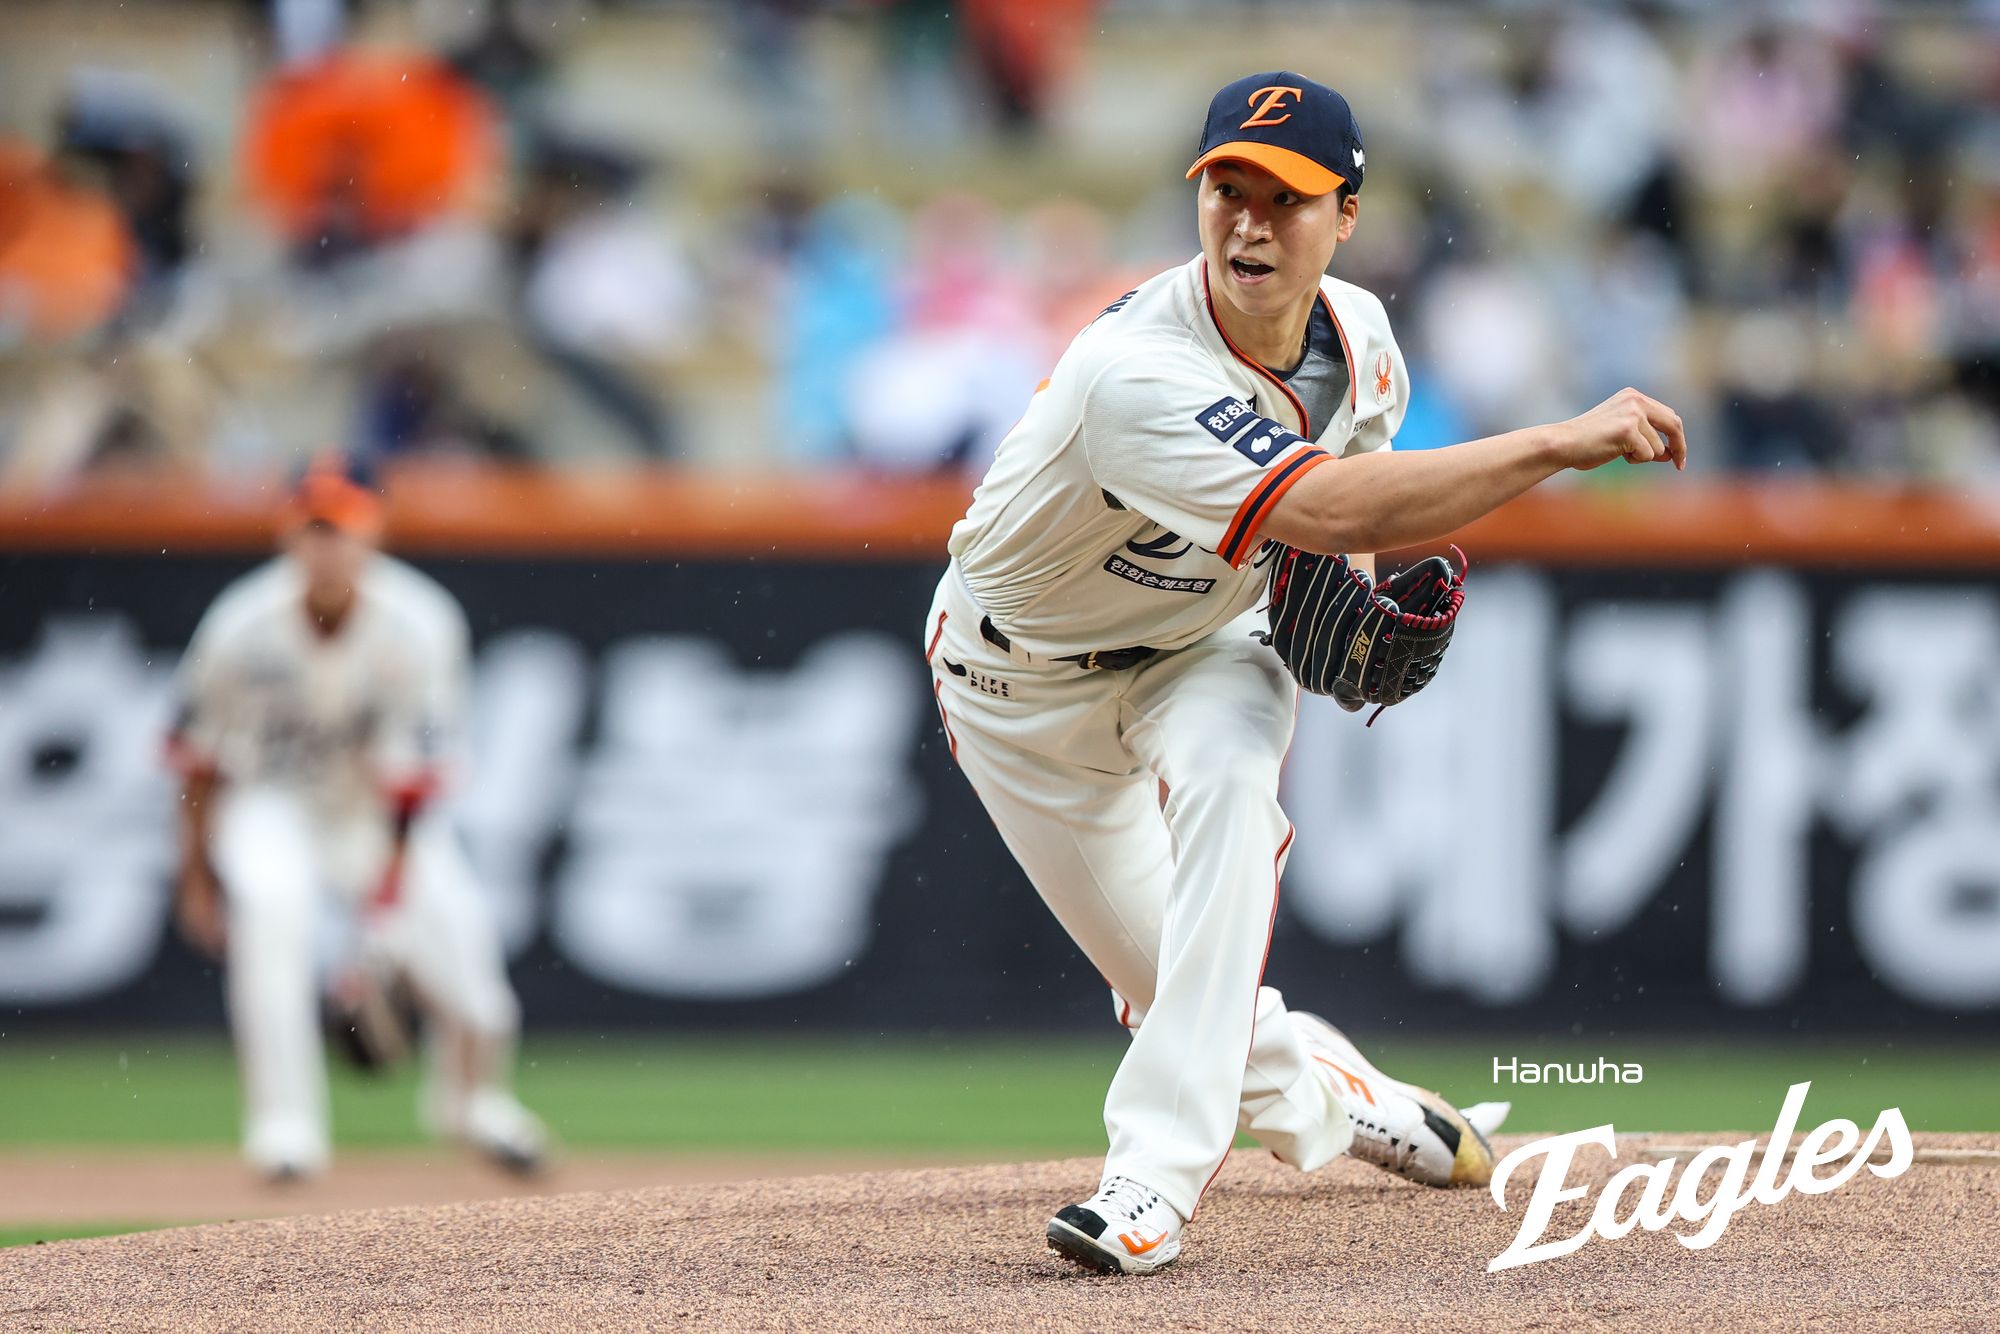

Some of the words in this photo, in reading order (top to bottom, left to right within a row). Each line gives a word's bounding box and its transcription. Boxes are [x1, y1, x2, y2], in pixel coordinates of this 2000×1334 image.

[1239, 86, 1302, 130] E
[1110, 558, 1212, 593] 한화손해보험
[1350, 629, 1371, 666] A2K
[970, 670, 1009, 691] LIFE
[970, 680, 1009, 698] PLUS
